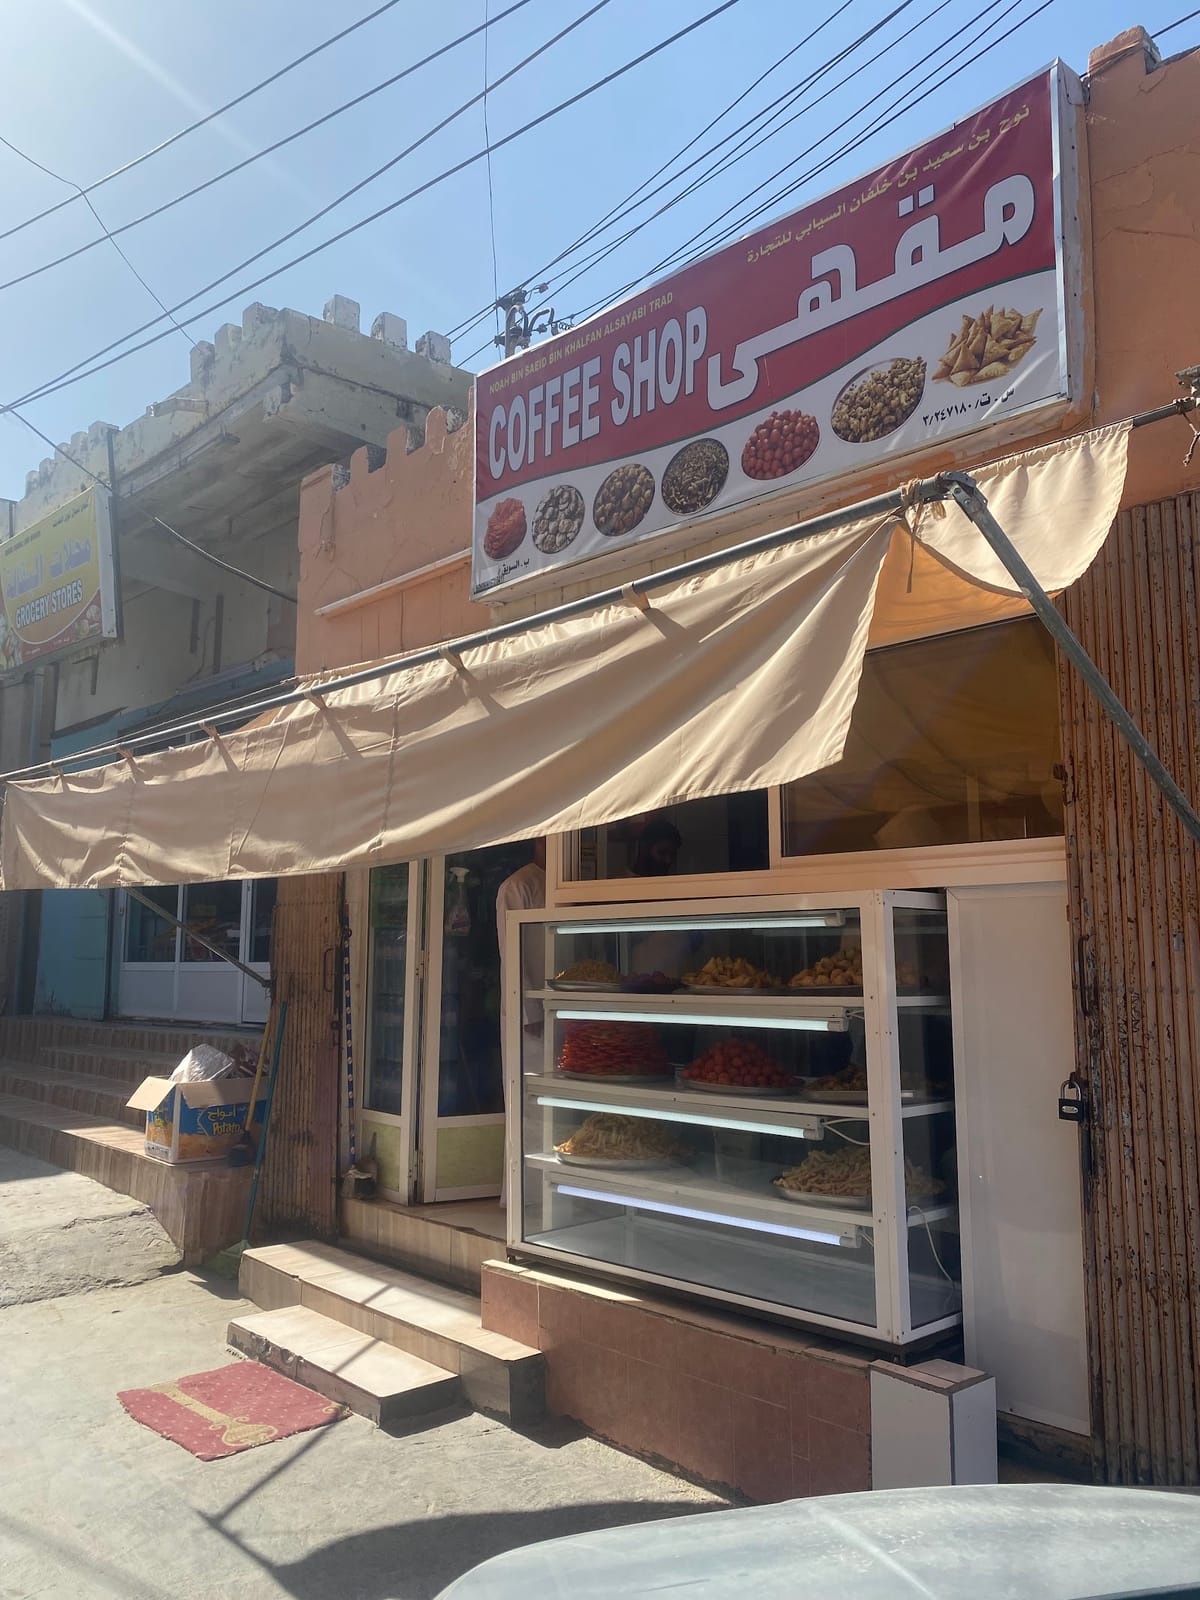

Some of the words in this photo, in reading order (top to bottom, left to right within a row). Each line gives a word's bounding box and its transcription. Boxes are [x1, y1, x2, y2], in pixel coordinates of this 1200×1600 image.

[1000, 104, 1030, 134] نوح
[968, 128, 991, 150] بن
[922, 143, 964, 171] سعيد
[897, 167, 918, 188] بن
[849, 178, 893, 214] خلفان
[746, 230, 793, 264] للتجارة
[489, 376, 510, 395] NOAH
[511, 369, 525, 384] BIN
[525, 356, 547, 377] SAEID
[549, 349, 563, 365] BIN
[564, 327, 602, 357] KHALFAN
[604, 303, 648, 337] ALSAYABI
[648, 291, 673, 313] TRAD
[489, 355, 601, 480] COFFEE
[610, 305, 708, 427] SHOP
[15, 592, 50, 630] GROCERY
[50, 577, 83, 614] STORES
